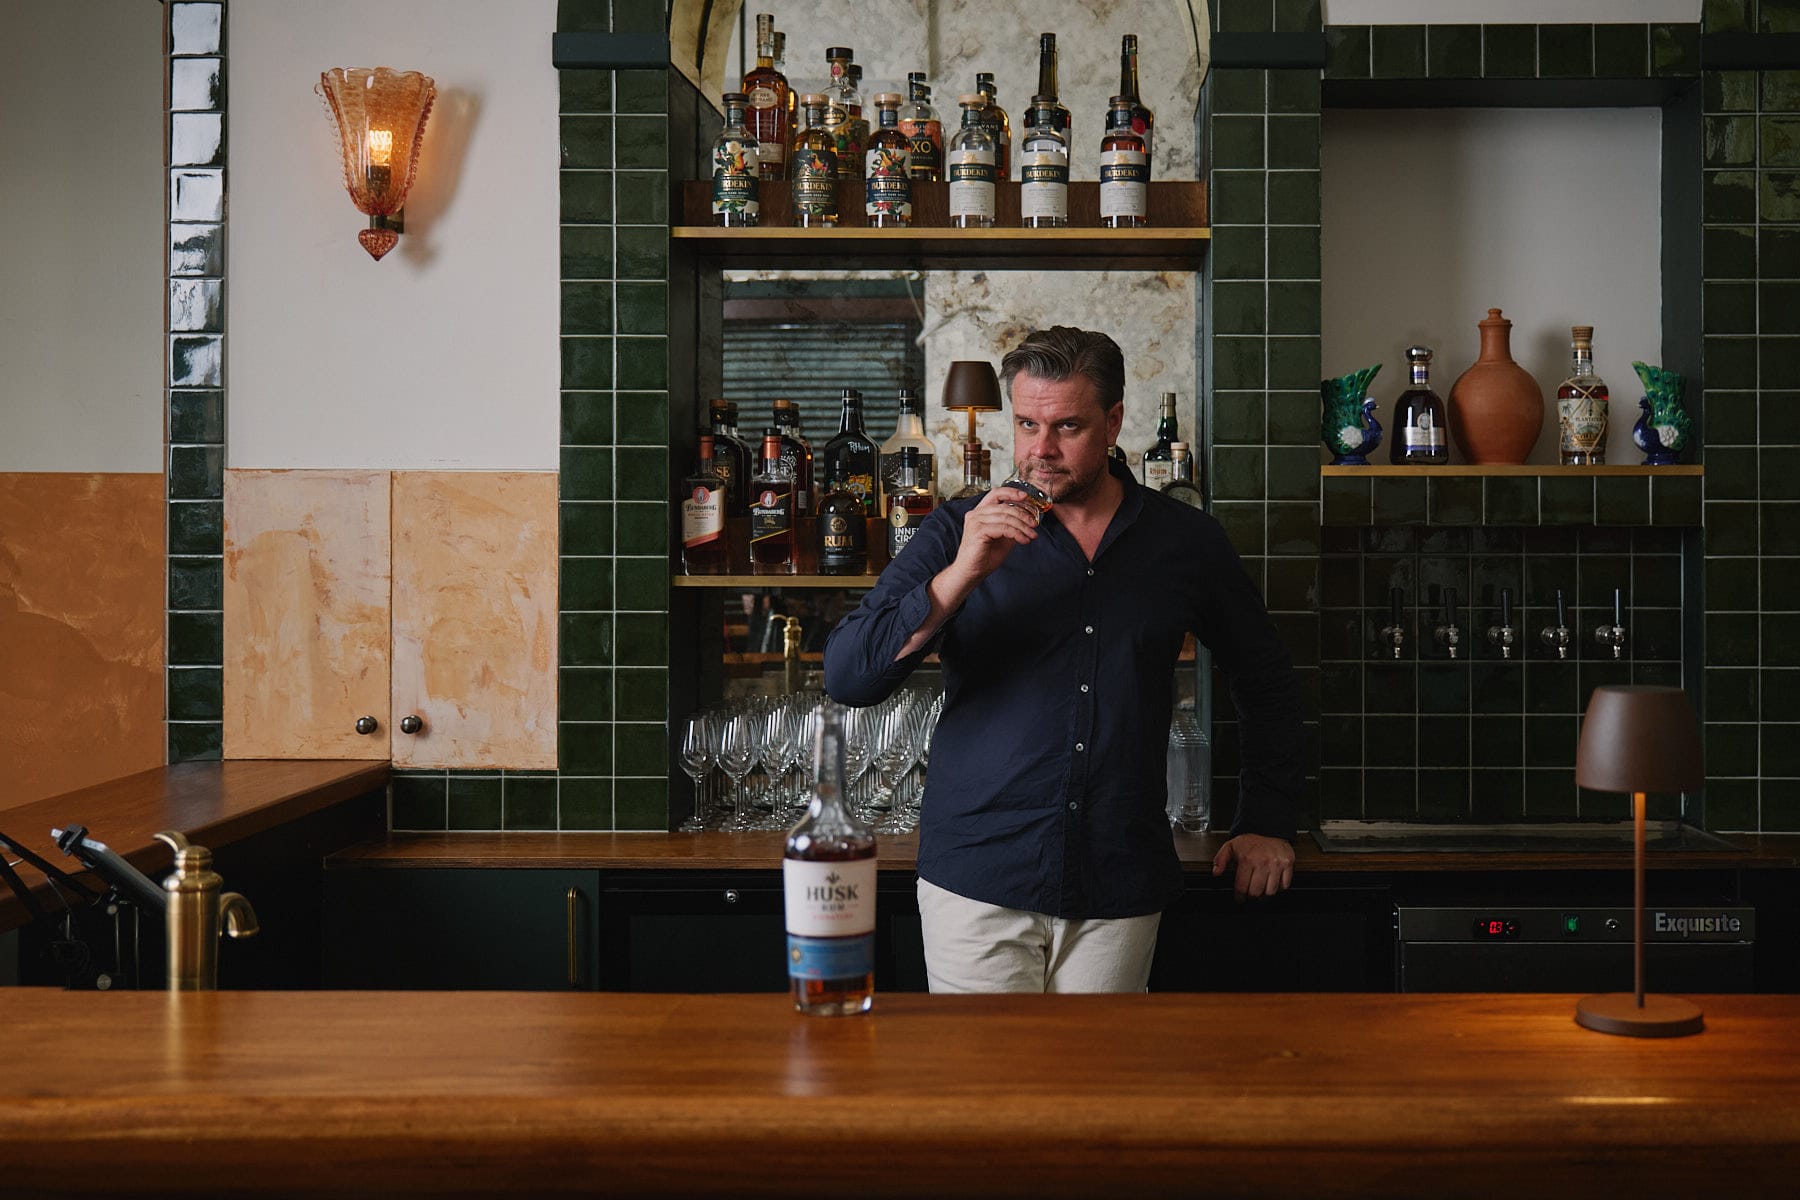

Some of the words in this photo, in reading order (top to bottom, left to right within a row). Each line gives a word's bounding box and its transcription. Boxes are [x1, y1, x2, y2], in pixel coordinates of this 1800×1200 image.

[911, 140, 932, 154] XO
[824, 535, 853, 547] RUM
[807, 885, 859, 901] HUSK
[1655, 912, 1741, 937] Exquisite
